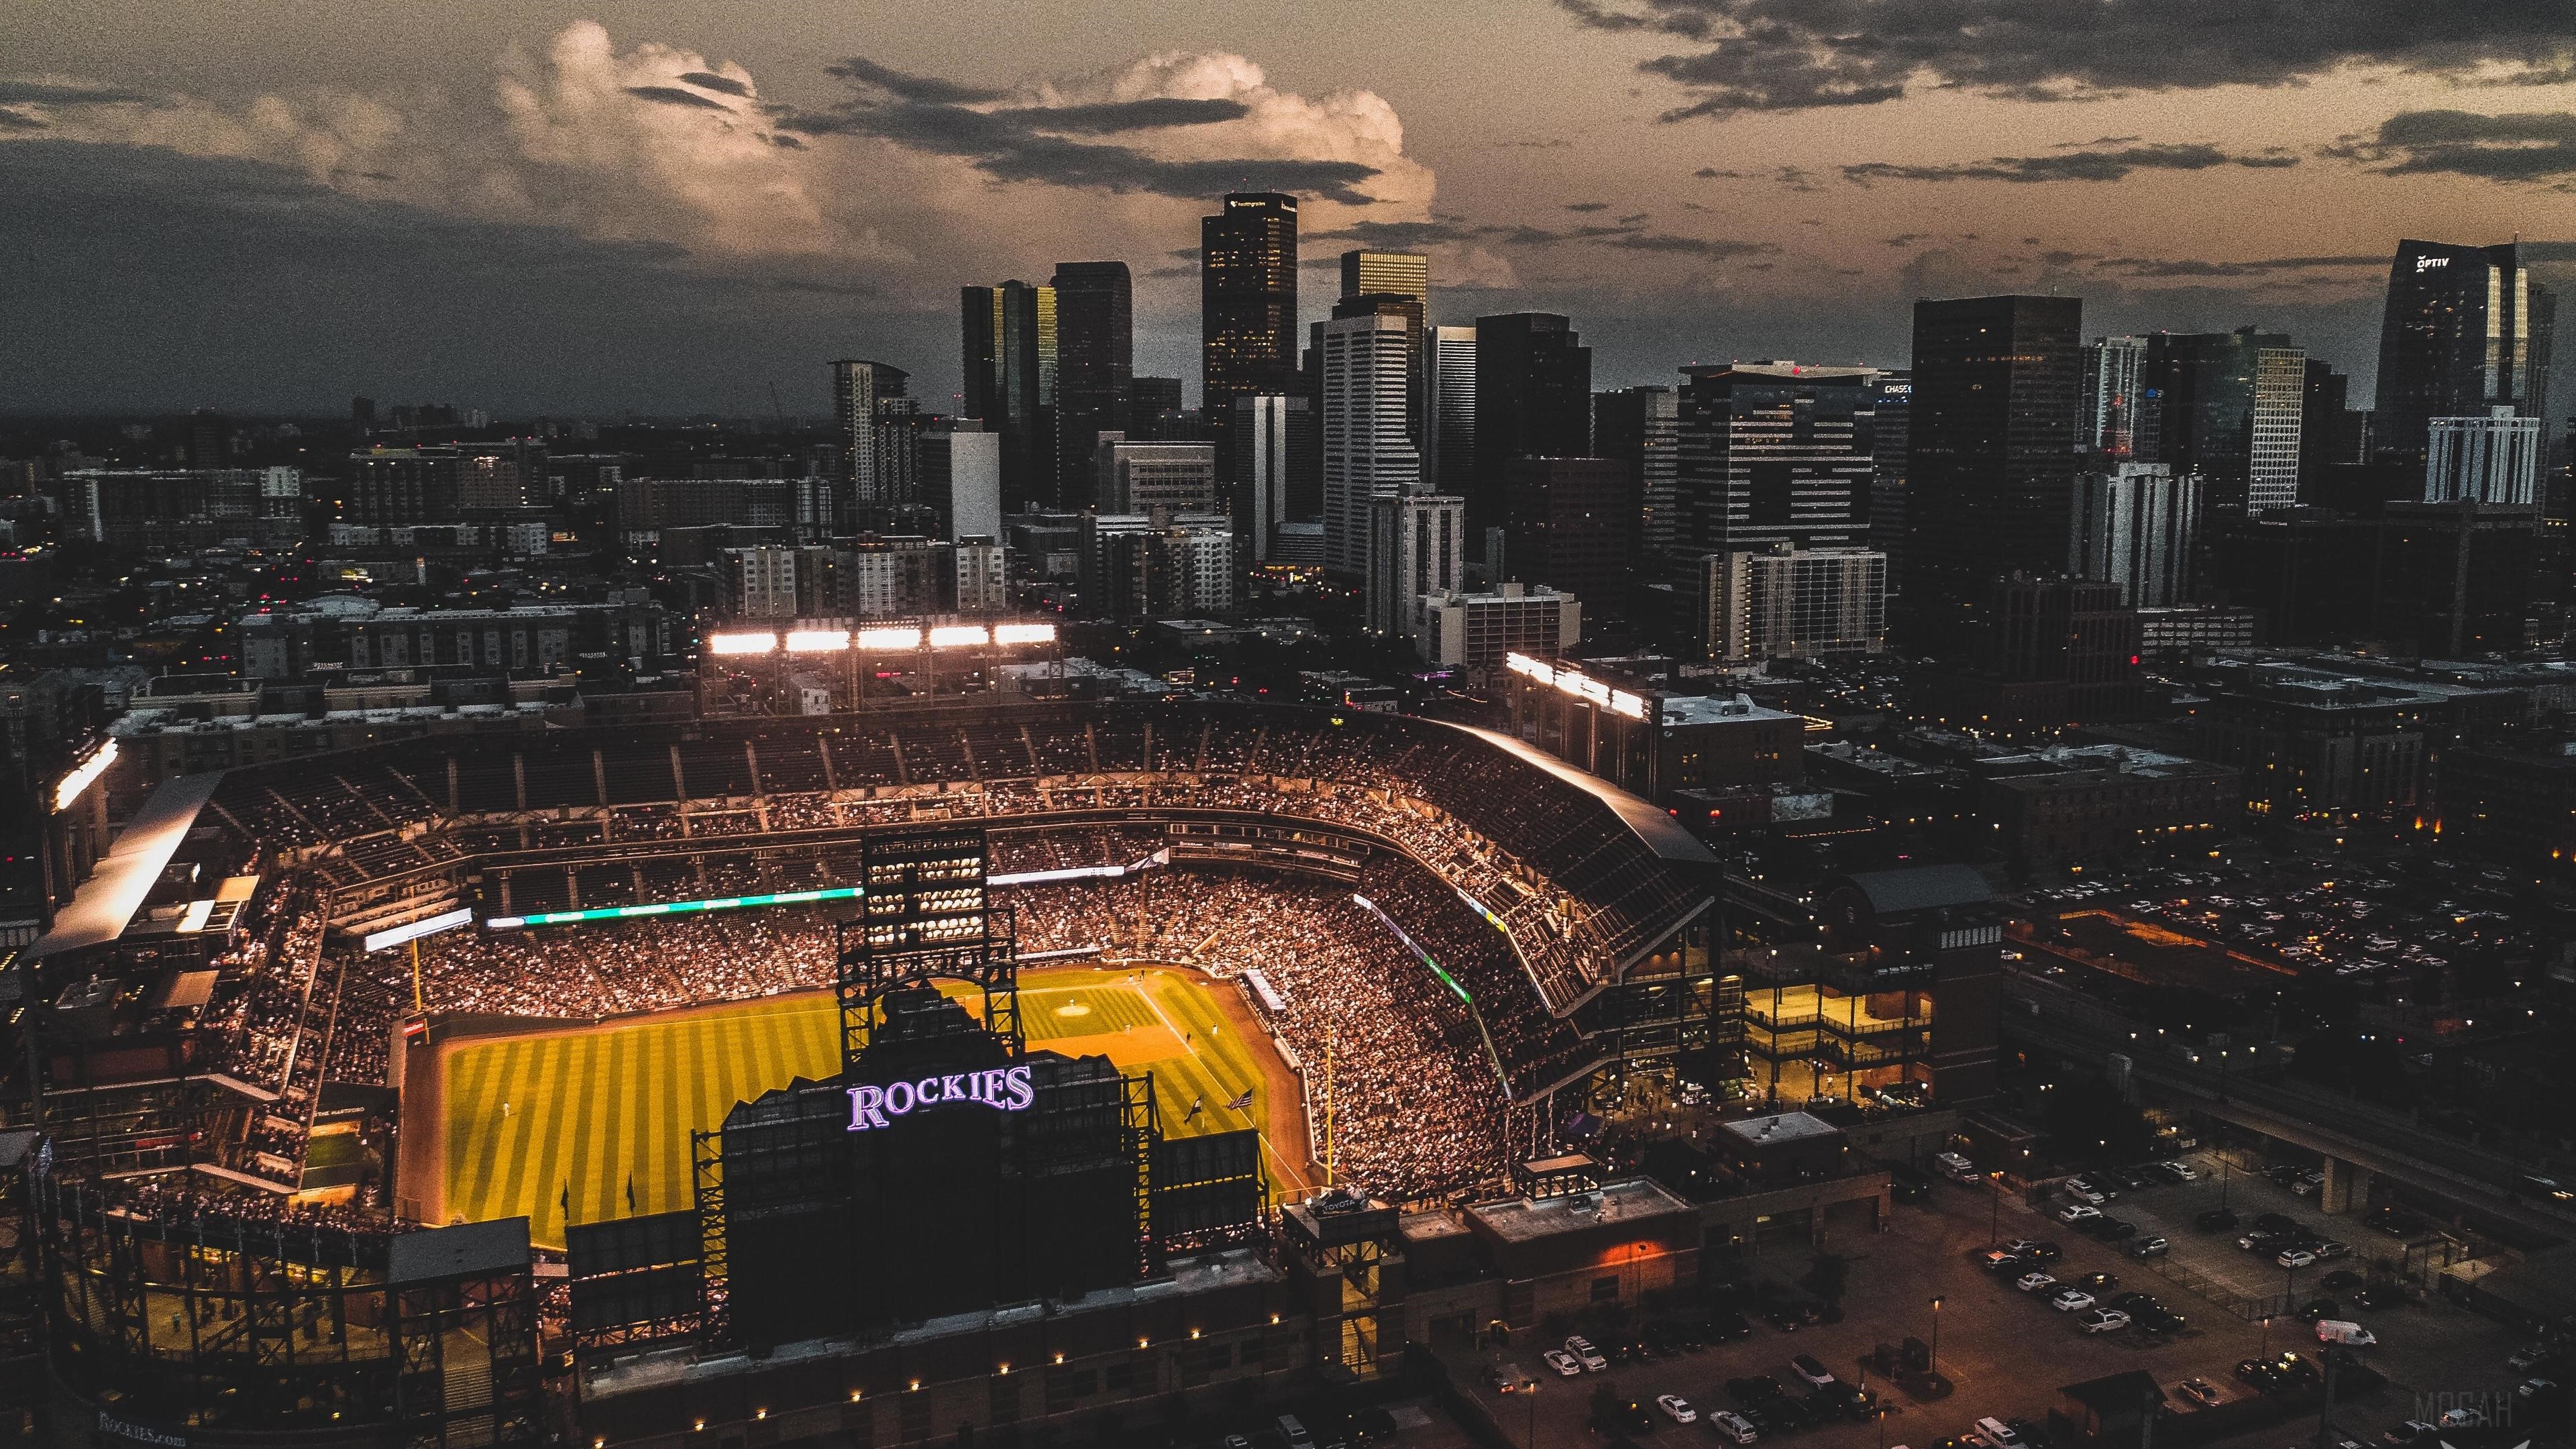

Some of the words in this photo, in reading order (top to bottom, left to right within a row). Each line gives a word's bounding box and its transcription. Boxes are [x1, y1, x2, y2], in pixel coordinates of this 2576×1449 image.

[2416, 255, 2449, 272] OPTIV
[1884, 385, 1909, 393] CHASE
[847, 1065, 1034, 1131] ROCKIES
[1322, 1199, 1355, 1211] TOYOTA
